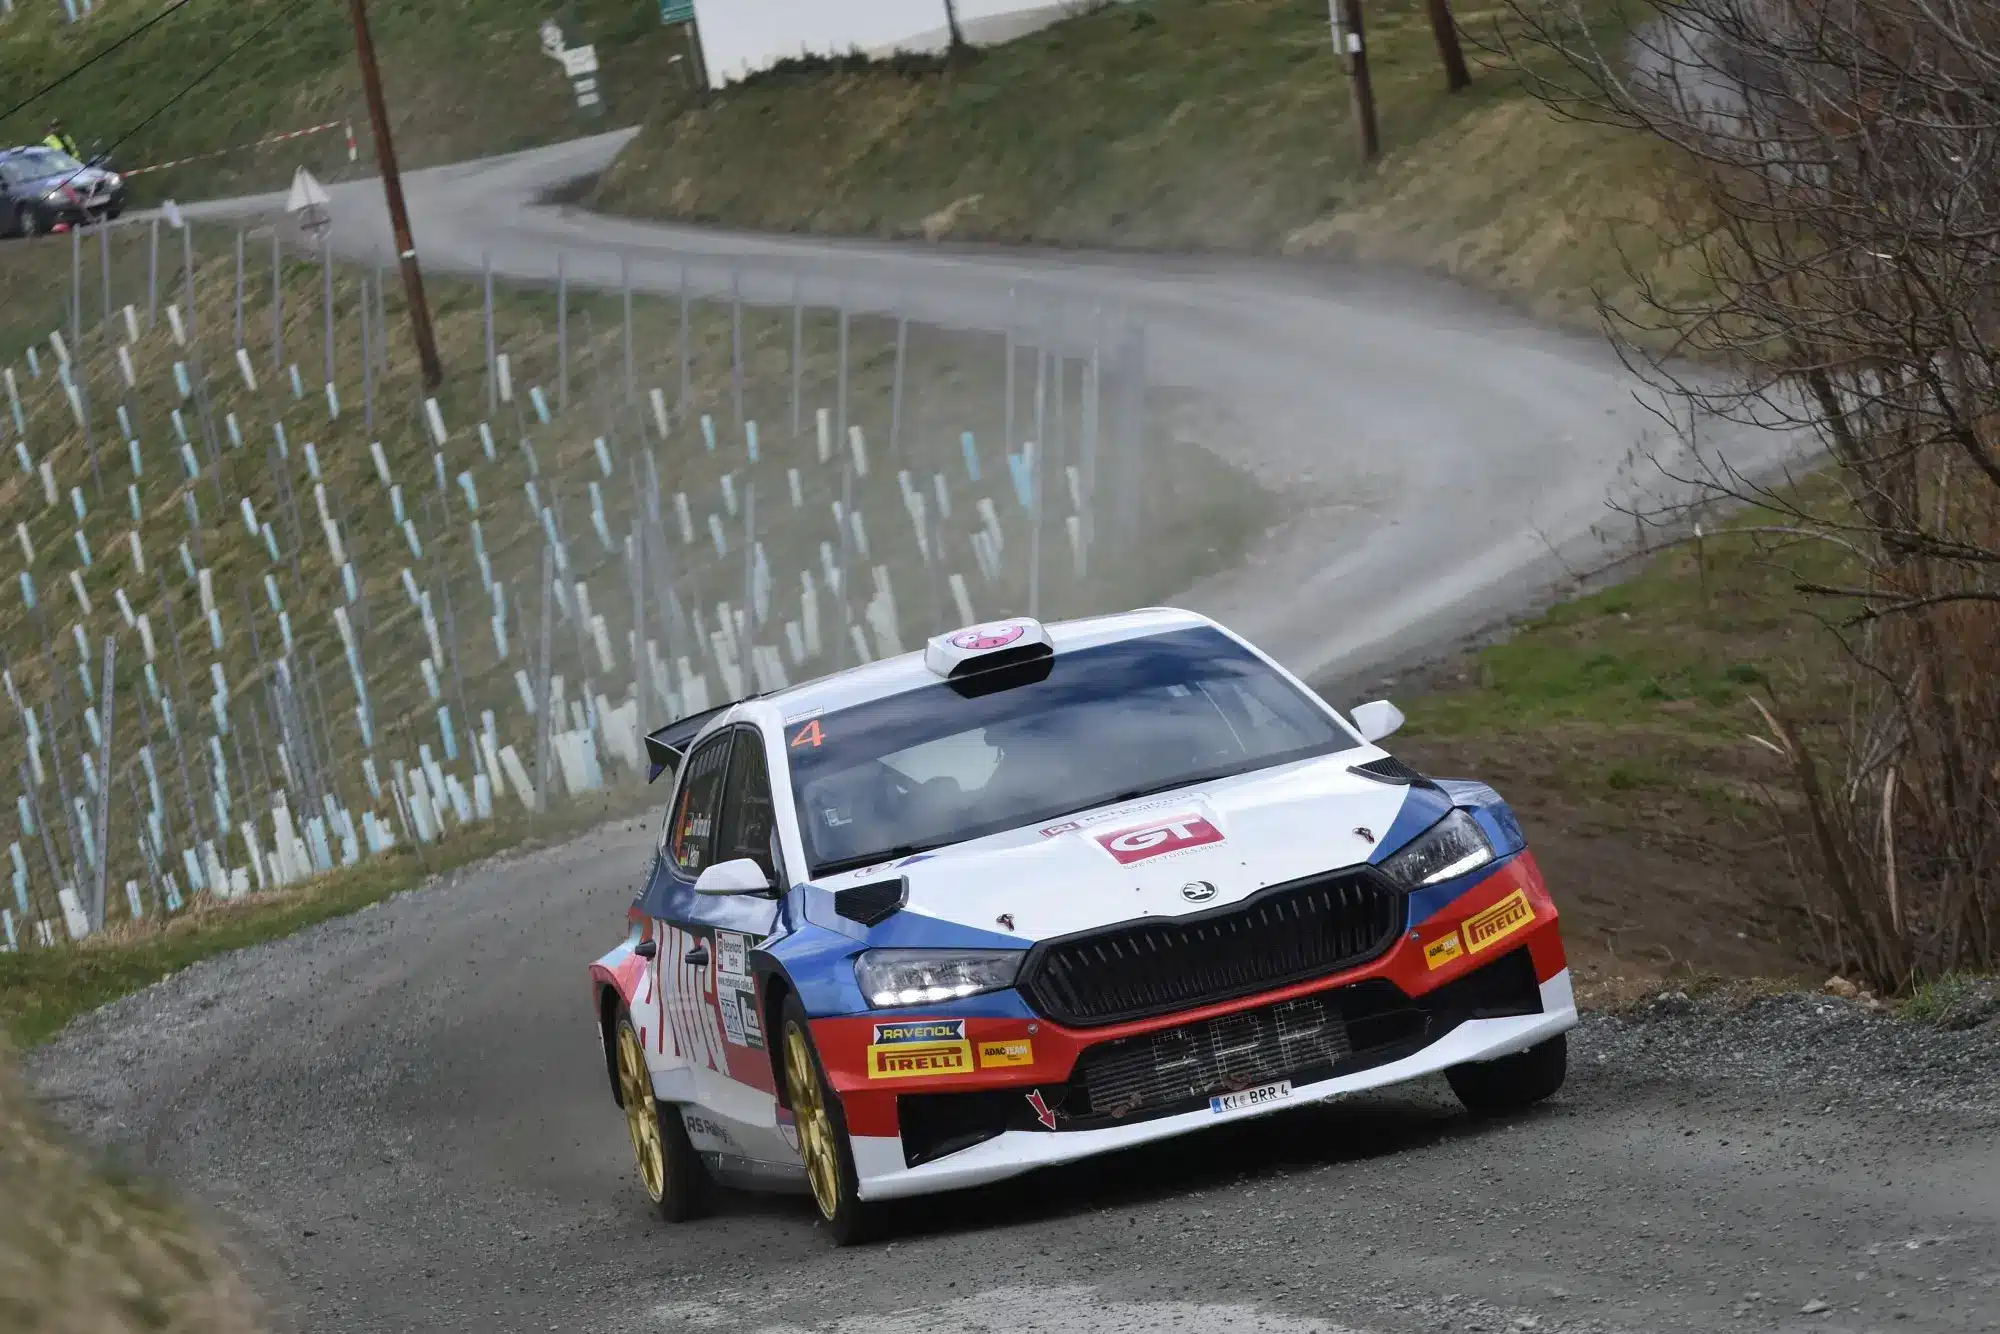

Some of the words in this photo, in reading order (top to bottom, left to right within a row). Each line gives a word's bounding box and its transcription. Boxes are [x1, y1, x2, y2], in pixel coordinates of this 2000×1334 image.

[791, 719, 828, 747] 4
[1111, 818, 1200, 851] GT
[1468, 895, 1527, 945] PIRELLI
[883, 1026, 955, 1040] RAVENOL
[877, 1047, 962, 1072] PIRELLI
[1223, 1095, 1238, 1110] KI
[1249, 1085, 1278, 1104] BRR
[1281, 1083, 1289, 1096] 4
